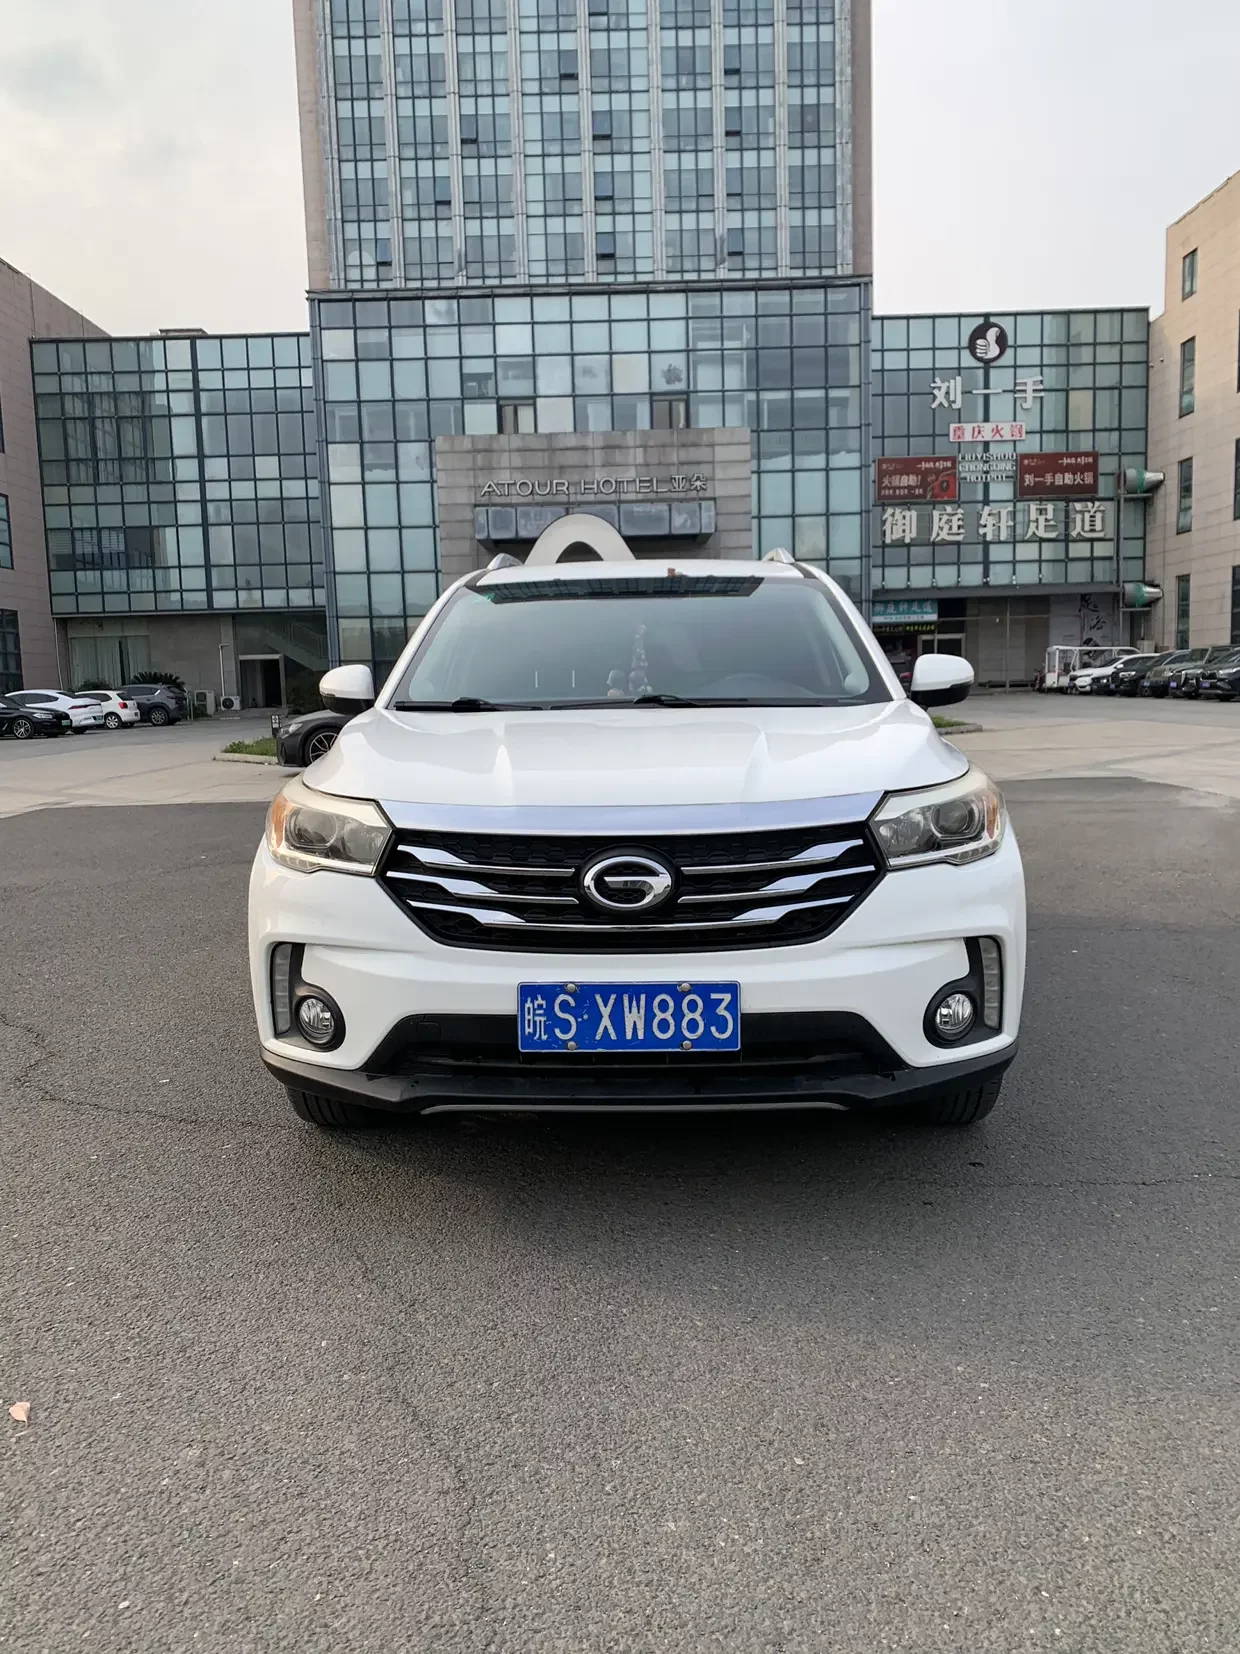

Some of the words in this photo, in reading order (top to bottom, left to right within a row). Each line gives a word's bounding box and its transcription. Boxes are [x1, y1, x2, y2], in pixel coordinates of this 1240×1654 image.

[929, 375, 1045, 409] 刘一手
[952, 424, 1023, 440] 重庆火锅
[959, 452, 1017, 461] LIUYISHOU
[959, 462, 1016, 472] CHONGQING
[481, 478, 569, 497] ATOUR
[580, 475, 669, 494] HOTEL
[669, 473, 708, 492] 亚朵
[966, 473, 1007, 482] HOTPOT
[882, 501, 1106, 543] 御庭轩足道
